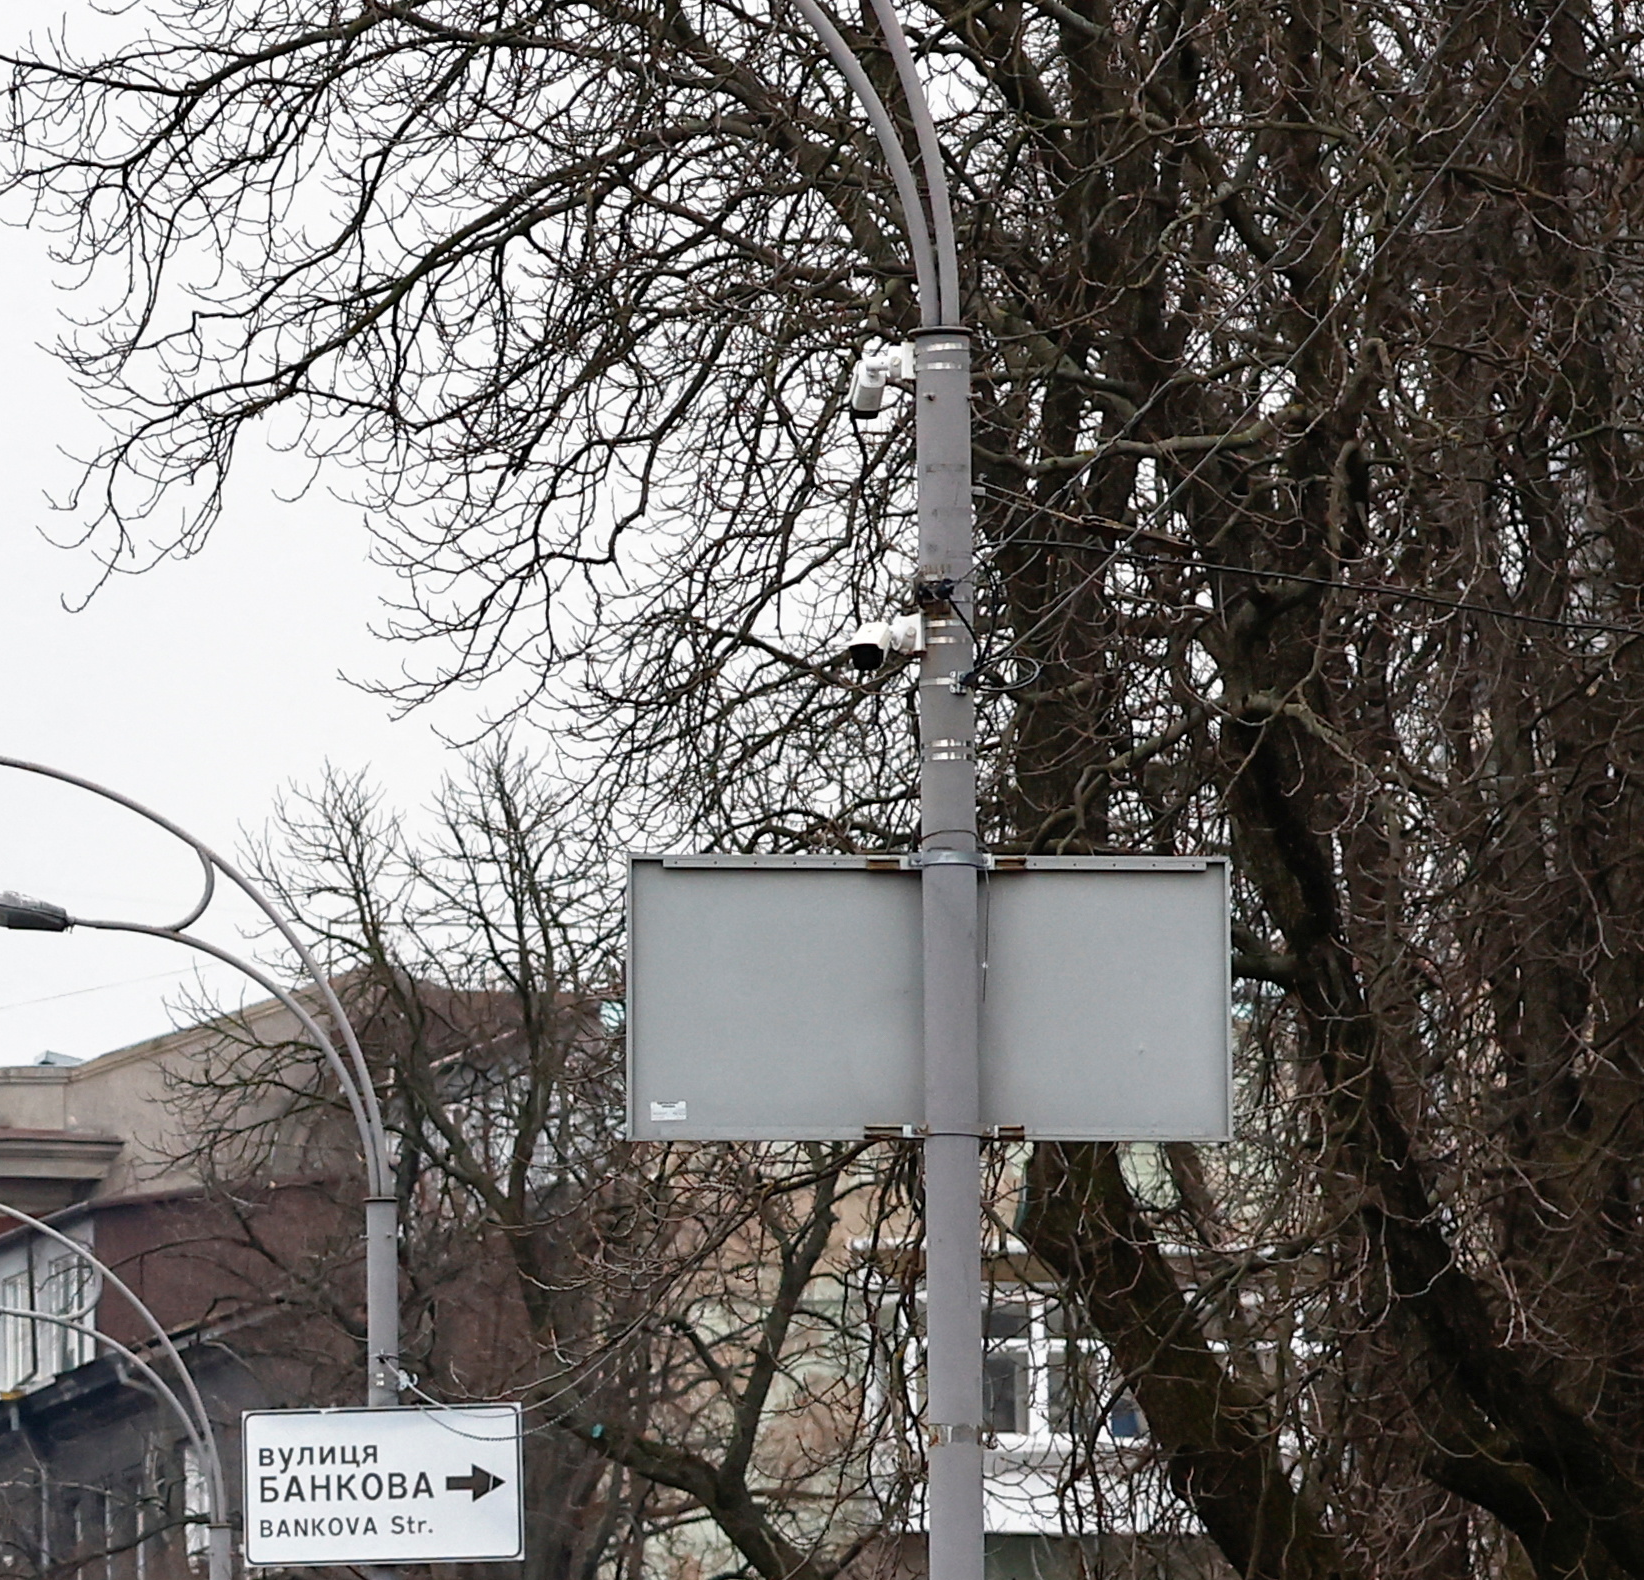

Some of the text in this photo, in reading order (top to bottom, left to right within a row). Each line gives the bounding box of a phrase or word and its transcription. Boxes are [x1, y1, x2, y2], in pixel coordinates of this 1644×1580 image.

[259, 1471, 435, 1503] БАНКОВА
[259, 1516, 434, 1538] BANKOVA Str.
